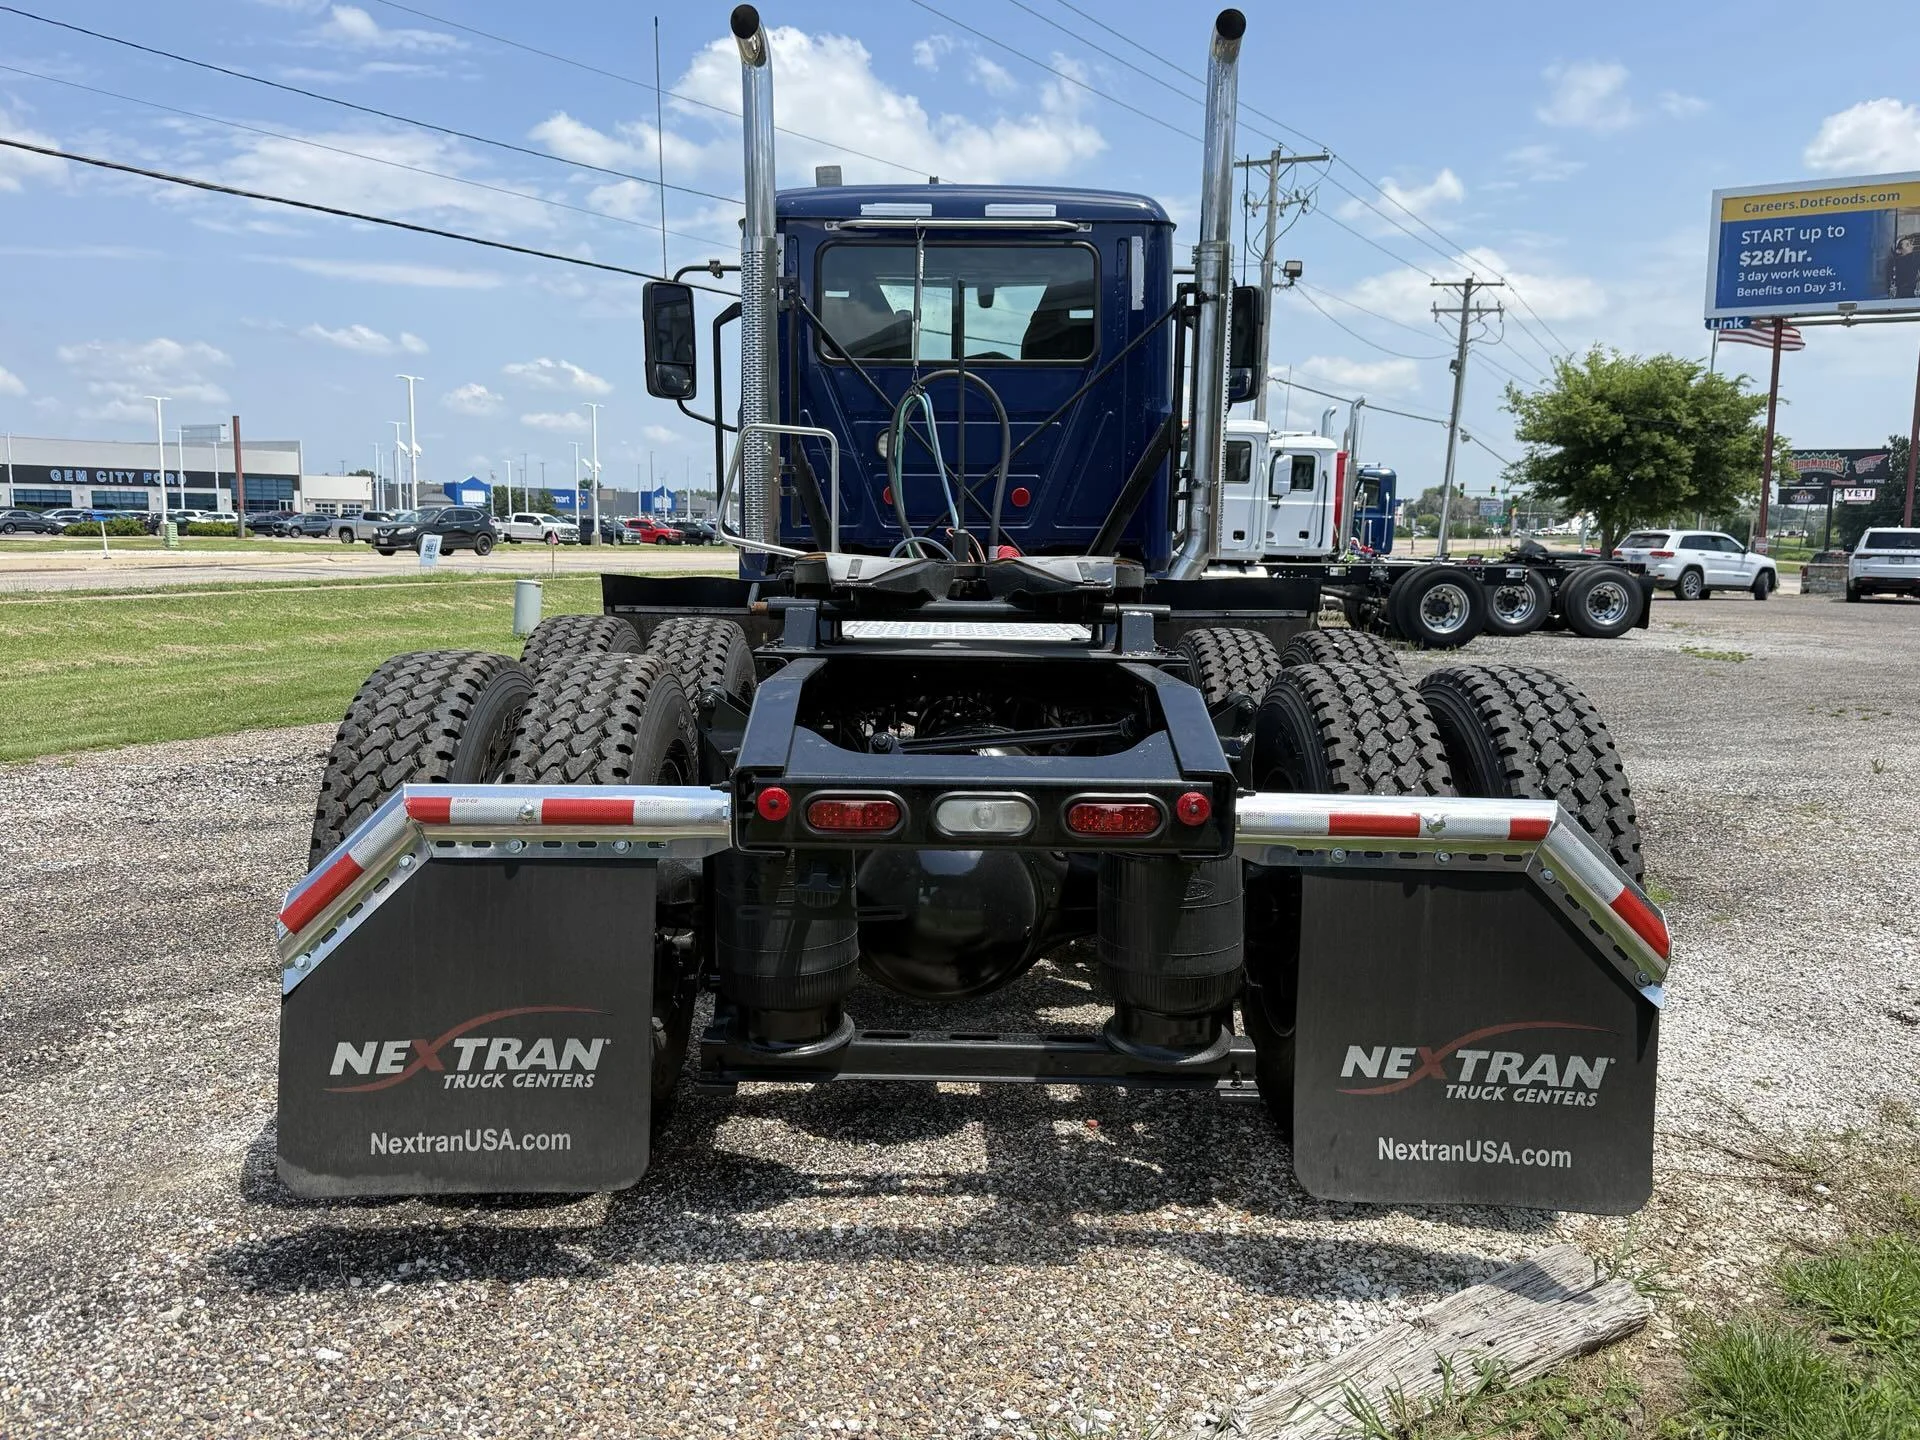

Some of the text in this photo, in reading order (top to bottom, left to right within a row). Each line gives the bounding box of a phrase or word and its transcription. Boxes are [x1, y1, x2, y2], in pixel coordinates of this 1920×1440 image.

[1743, 191, 1901, 213] Careers.DotFoods.com
[1741, 225, 1845, 245] START up to
[1739, 248, 1813, 267] $28/hr.
[1738, 267, 1836, 283] 3 day work week.
[1736, 281, 1846, 297] Benefits on Day 31.
[50, 469, 88, 482] GEM
[96, 471, 136, 483] CITY
[1845, 489, 1873, 497] YETI
[443, 1073, 595, 1089] TRUCK CENTERS
[1445, 1084, 1598, 1107] TRUCK CENTERS
[370, 1128, 571, 1155] NextranUSA.com
[1378, 1137, 1572, 1168] NextranUSA.com
